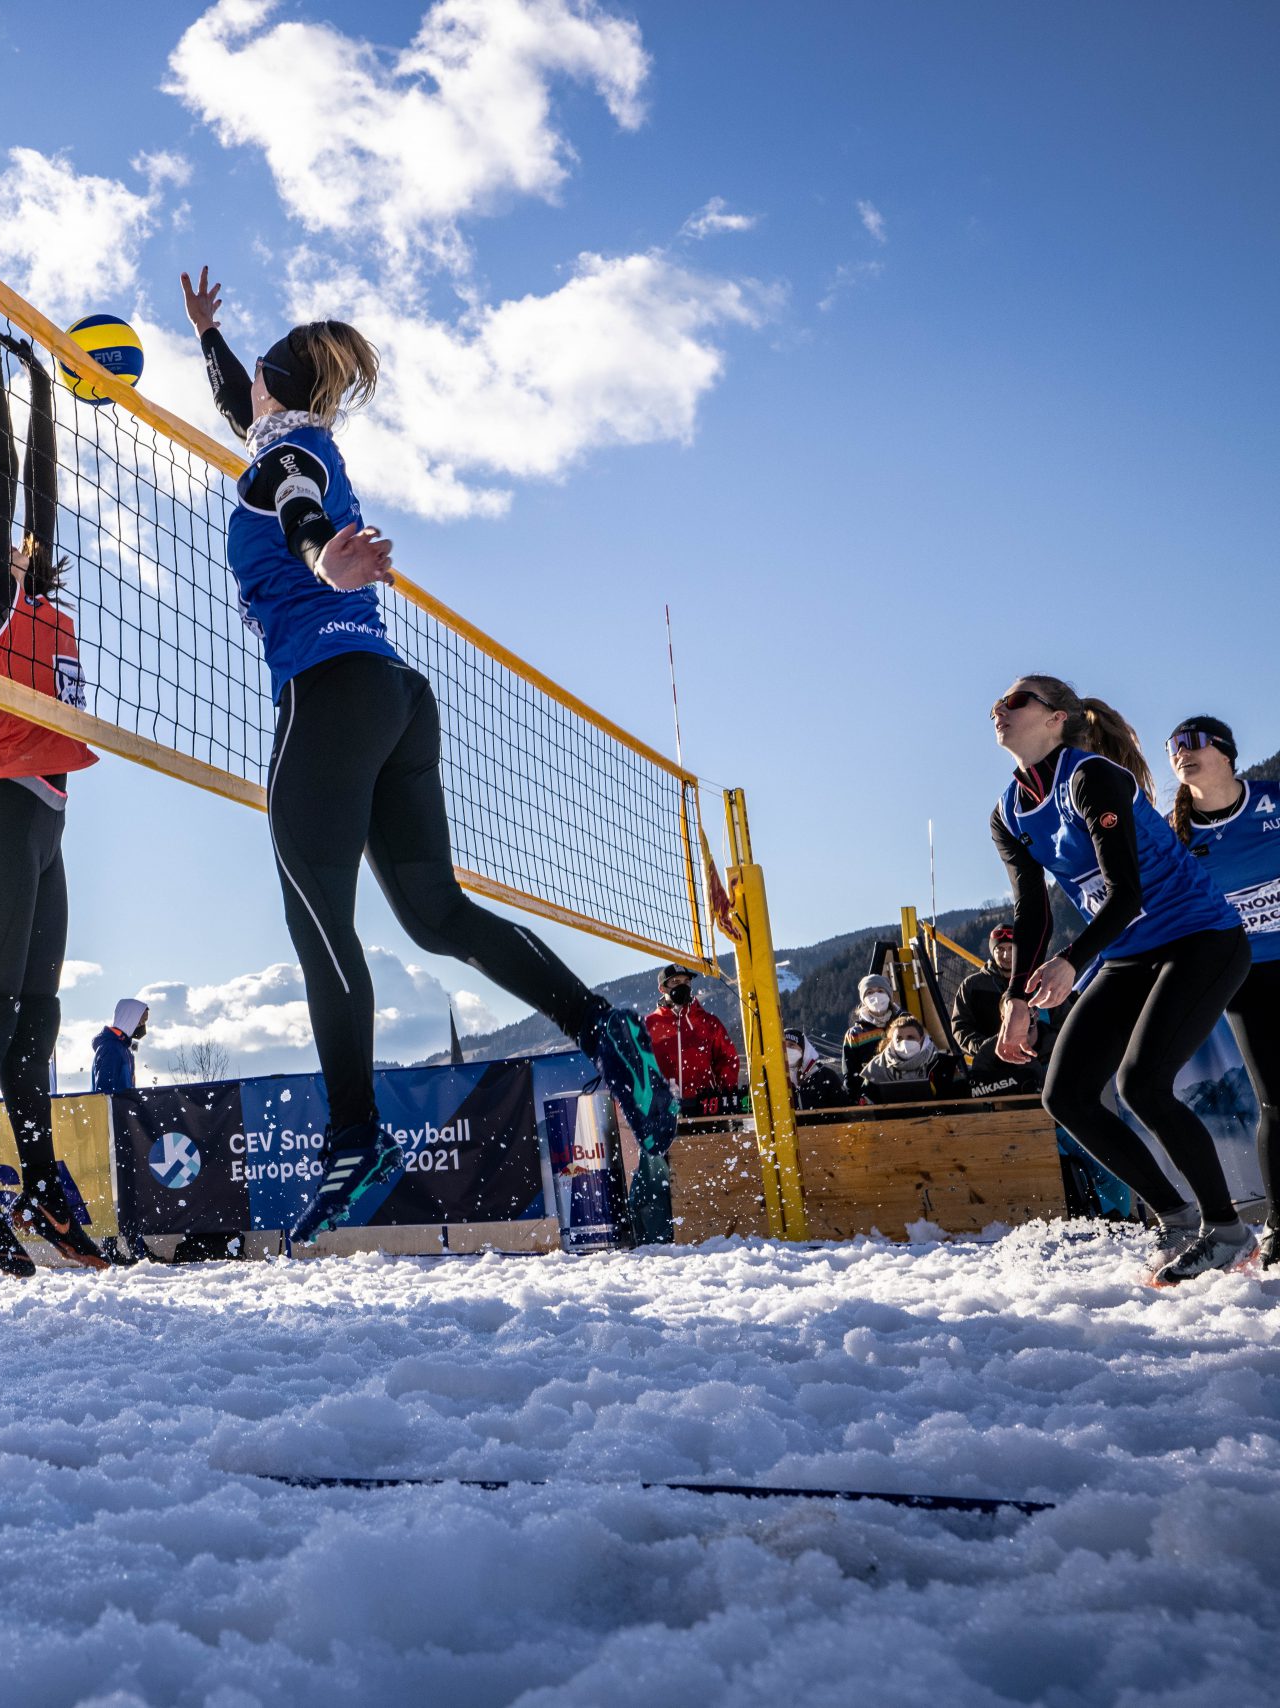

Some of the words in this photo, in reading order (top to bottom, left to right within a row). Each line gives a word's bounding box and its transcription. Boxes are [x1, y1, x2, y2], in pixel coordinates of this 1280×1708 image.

[94, 350, 123, 363] FIVB
[1254, 794, 1276, 814] 4
[229, 1132, 274, 1153] CEV
[280, 1129, 325, 1150] Sno
[405, 1149, 460, 1172] 2021
[573, 1143, 604, 1161] Bull
